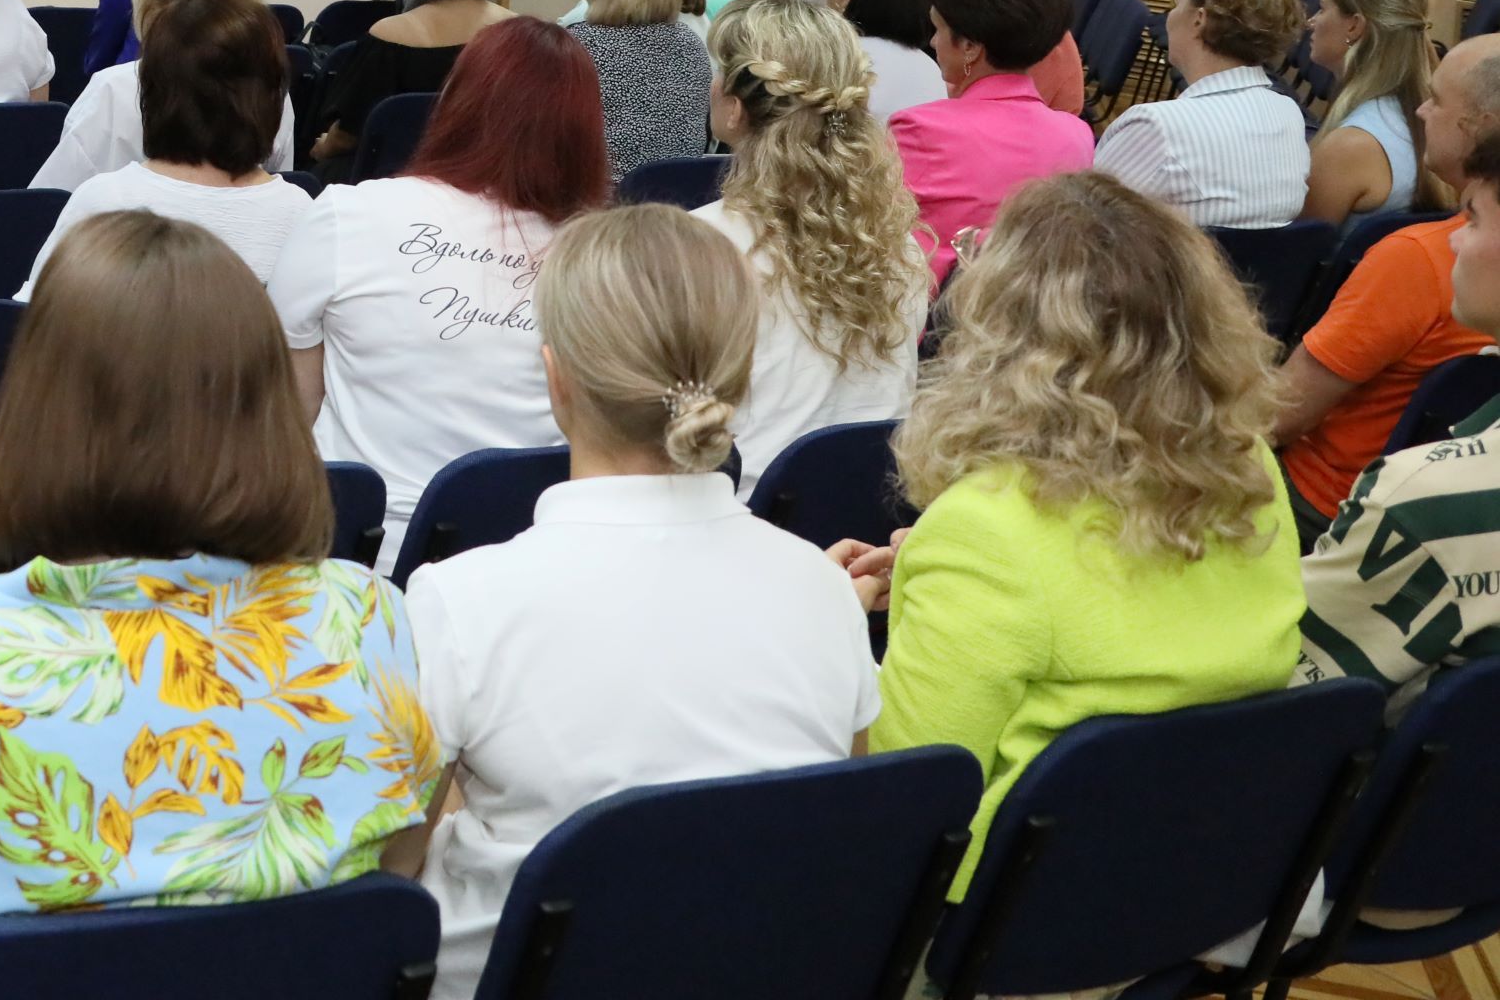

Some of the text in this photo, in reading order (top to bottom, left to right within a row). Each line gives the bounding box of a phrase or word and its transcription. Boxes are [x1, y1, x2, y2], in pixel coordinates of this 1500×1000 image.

[399, 223, 496, 273] Вдоль
[499, 254, 527, 269] по
[420, 287, 536, 340] Пушки
